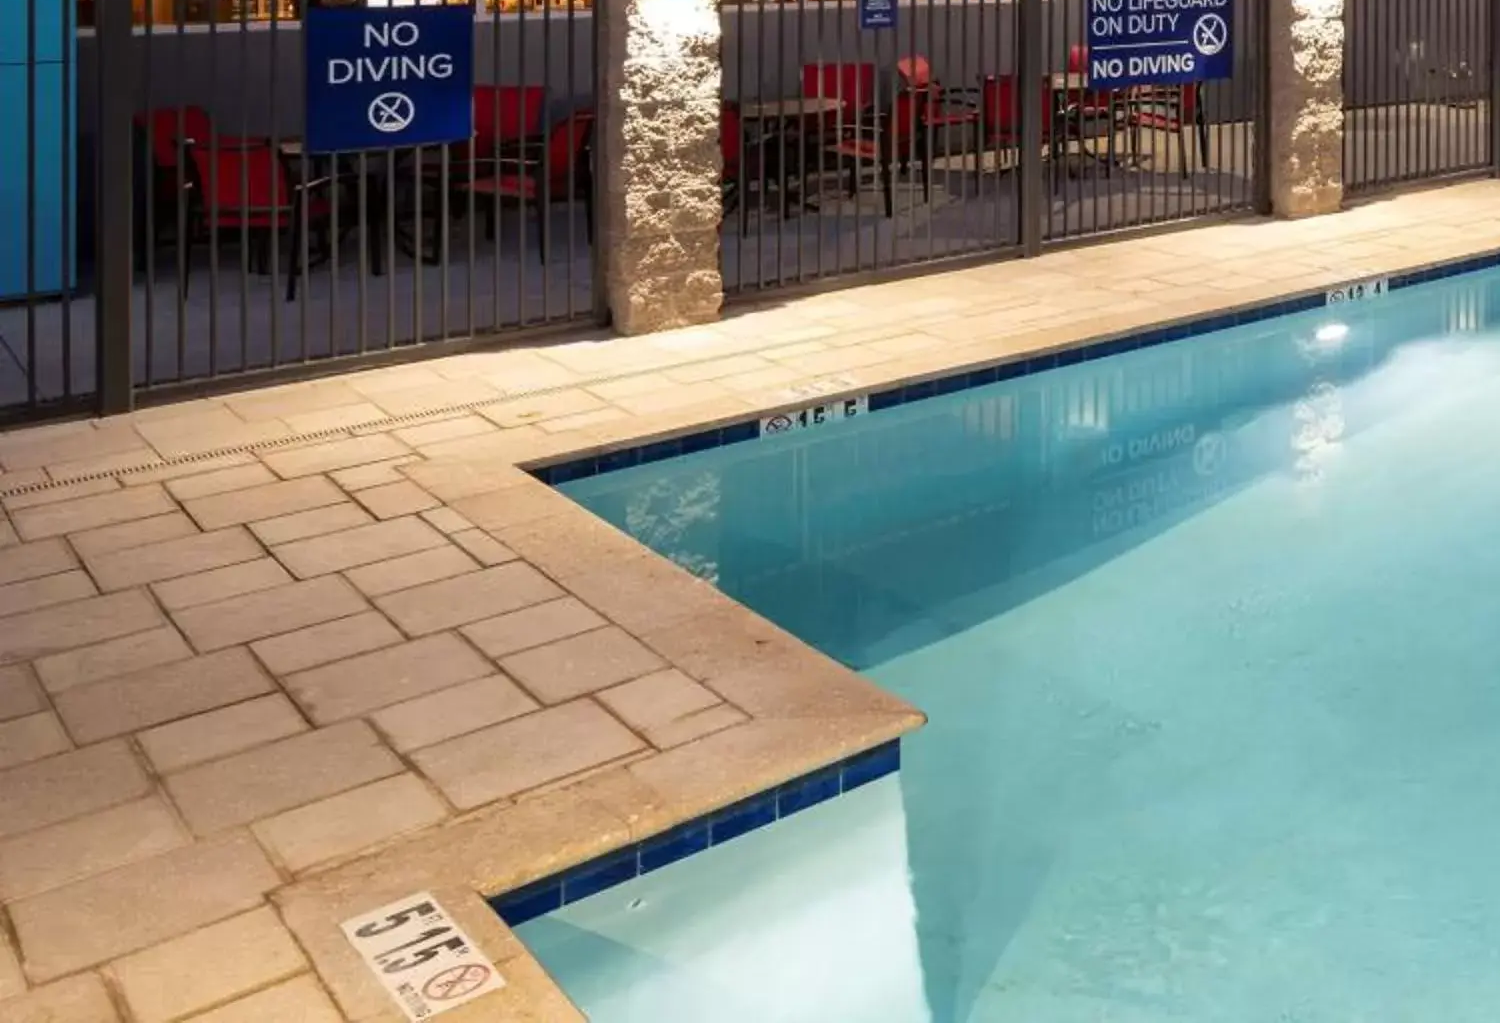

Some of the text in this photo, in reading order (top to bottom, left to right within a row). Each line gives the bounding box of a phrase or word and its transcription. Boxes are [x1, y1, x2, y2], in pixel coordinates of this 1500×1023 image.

[363, 21, 419, 48] NO
[1092, 12, 1180, 37] ON DUTY
[327, 53, 453, 84] DIVING
[1092, 52, 1195, 80] NO DIVING
[355, 900, 437, 938] 5
